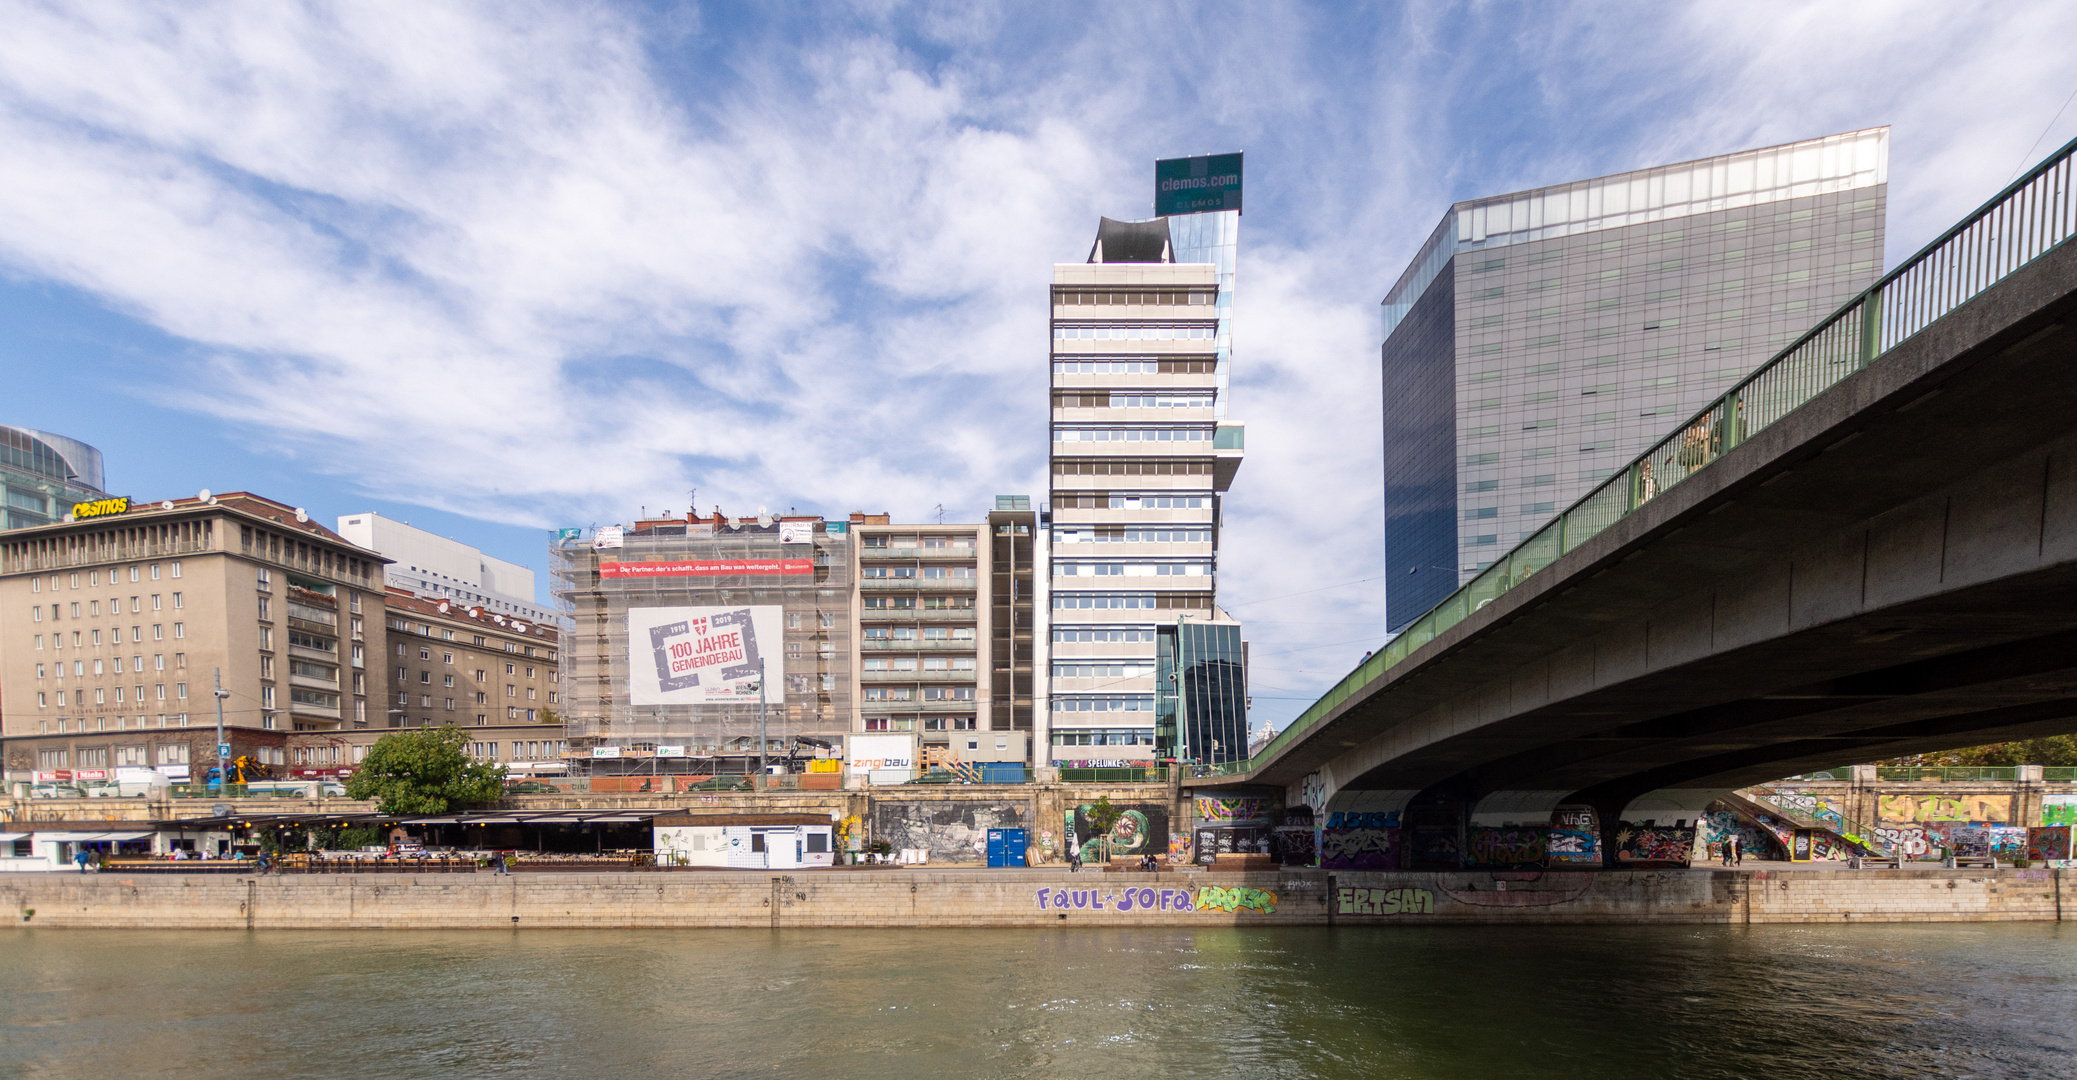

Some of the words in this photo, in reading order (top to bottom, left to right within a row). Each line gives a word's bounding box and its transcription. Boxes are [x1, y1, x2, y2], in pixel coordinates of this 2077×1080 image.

[1162, 174, 1238, 192] clemos.com
[1176, 198, 1221, 208] CLEMOS
[73, 498, 127, 518] cosmos
[714, 615, 732, 625] 2019
[670, 624, 686, 634] 1919
[669, 641, 693, 659] 100
[695, 632, 741, 654] JAHRE
[672, 648, 743, 672] GEMEINDEBAU
[854, 758, 909, 769] zinglbau
